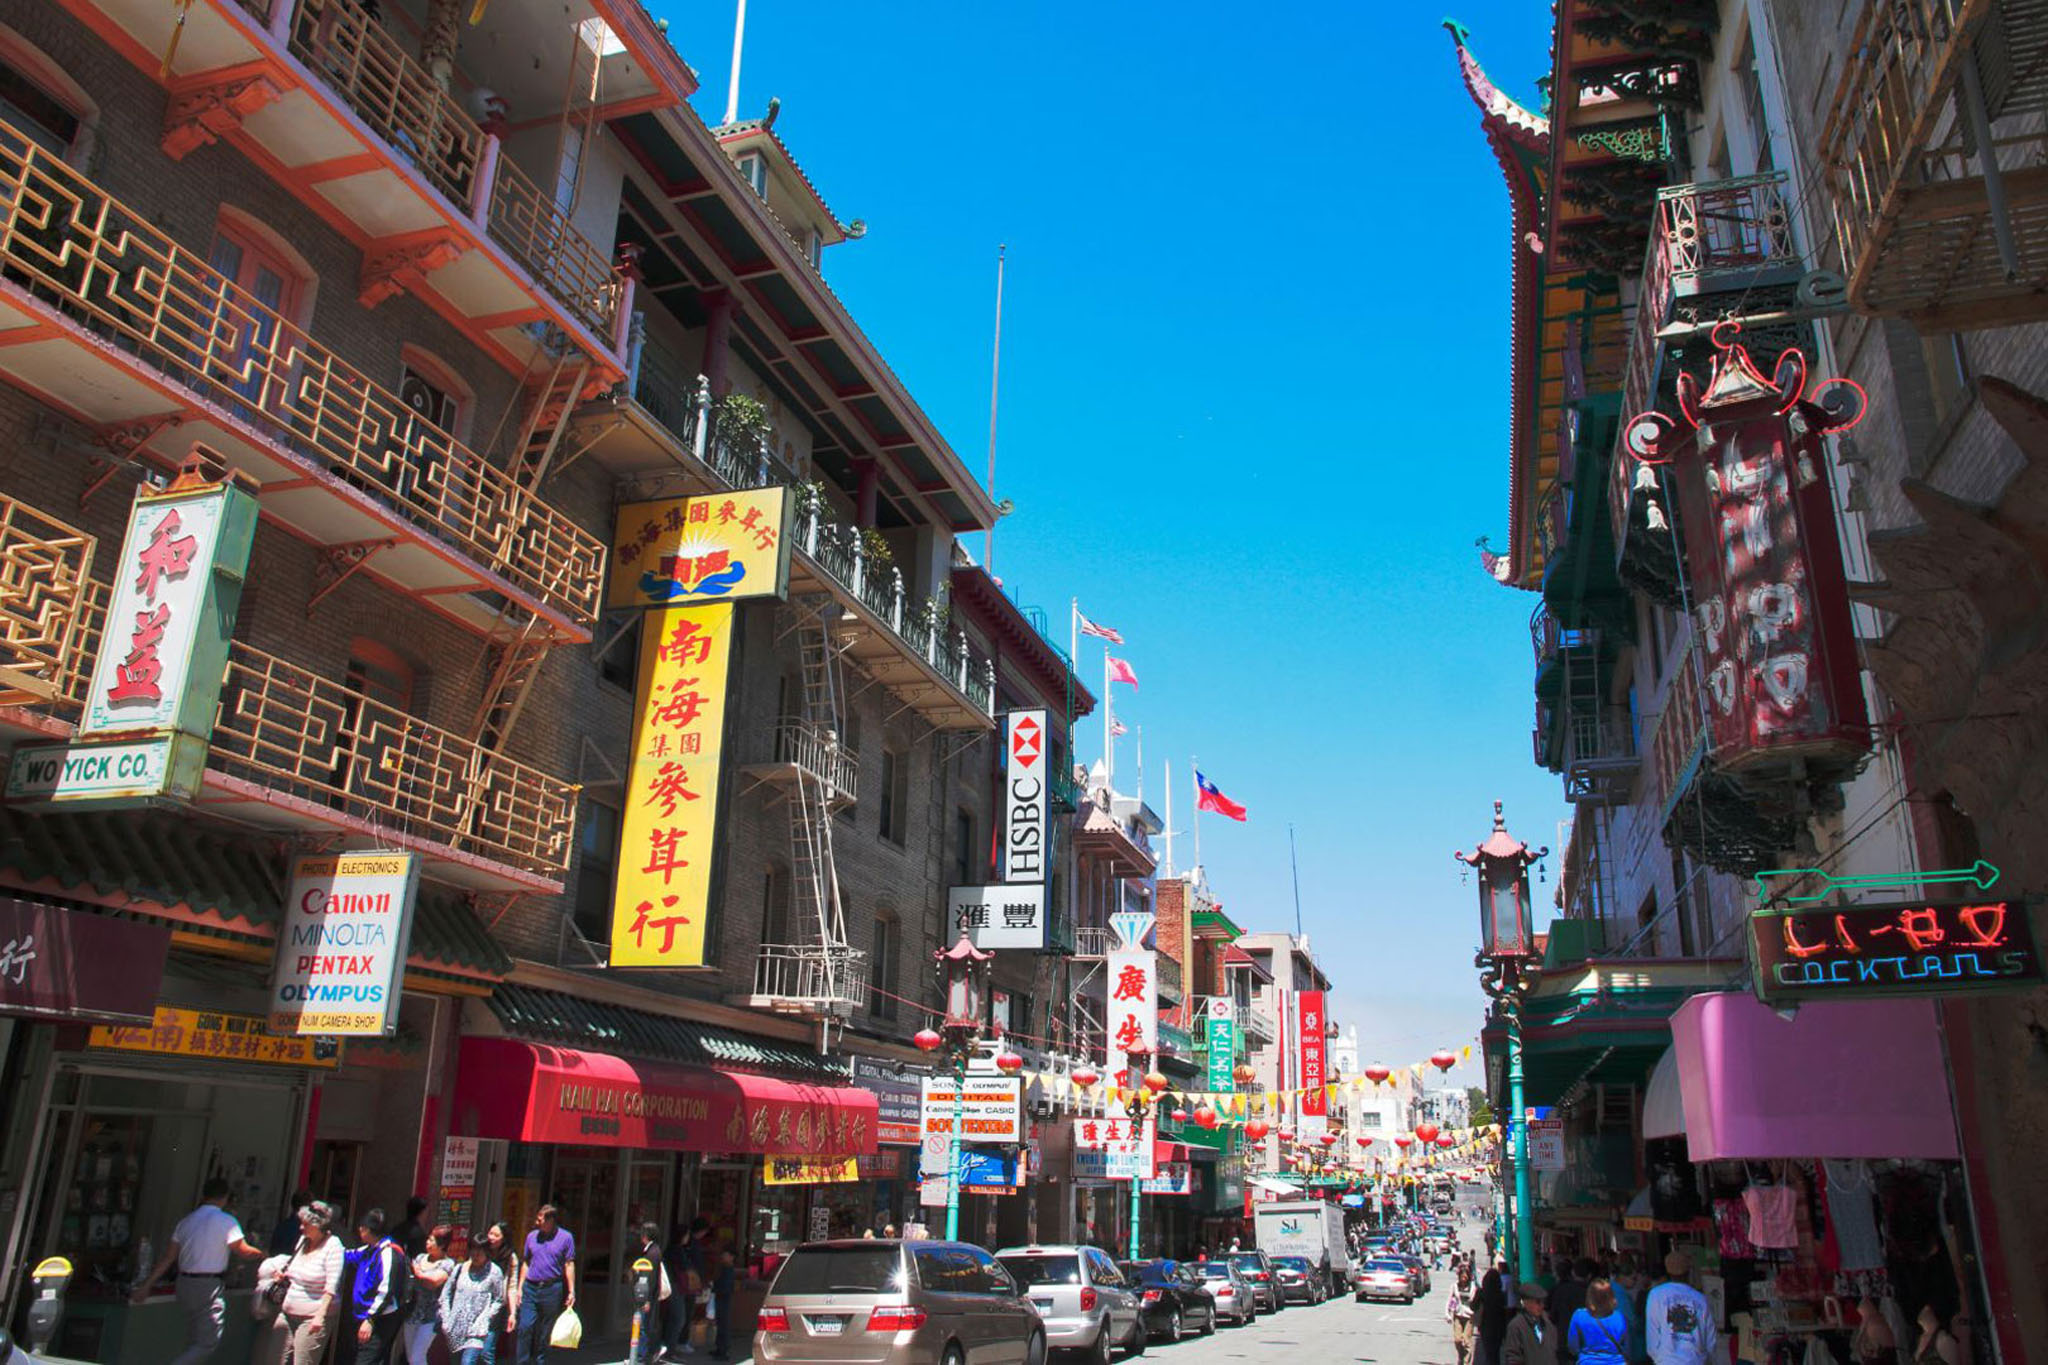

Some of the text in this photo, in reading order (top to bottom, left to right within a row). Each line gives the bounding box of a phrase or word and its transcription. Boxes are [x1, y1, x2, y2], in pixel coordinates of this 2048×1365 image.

[26, 753, 149, 784] WO YICK CO.
[1011, 776, 1041, 877] HSBC
[341, 861, 400, 874] ELECTRONICS
[301, 888, 391, 915] Canon
[292, 923, 386, 946] MINOLTA
[296, 955, 374, 975] PENTAX
[280, 985, 383, 1002] OLYMPUS
[225, 1017, 247, 1033] NUM
[301, 1014, 318, 1027] NUM
[321, 1015, 351, 1028] CAMERA
[354, 1015, 376, 1028] SHOP
[559, 1083, 593, 1111] NAM
[622, 1090, 709, 1121] CORPORATION
[985, 1107, 1015, 1115] CASIO
